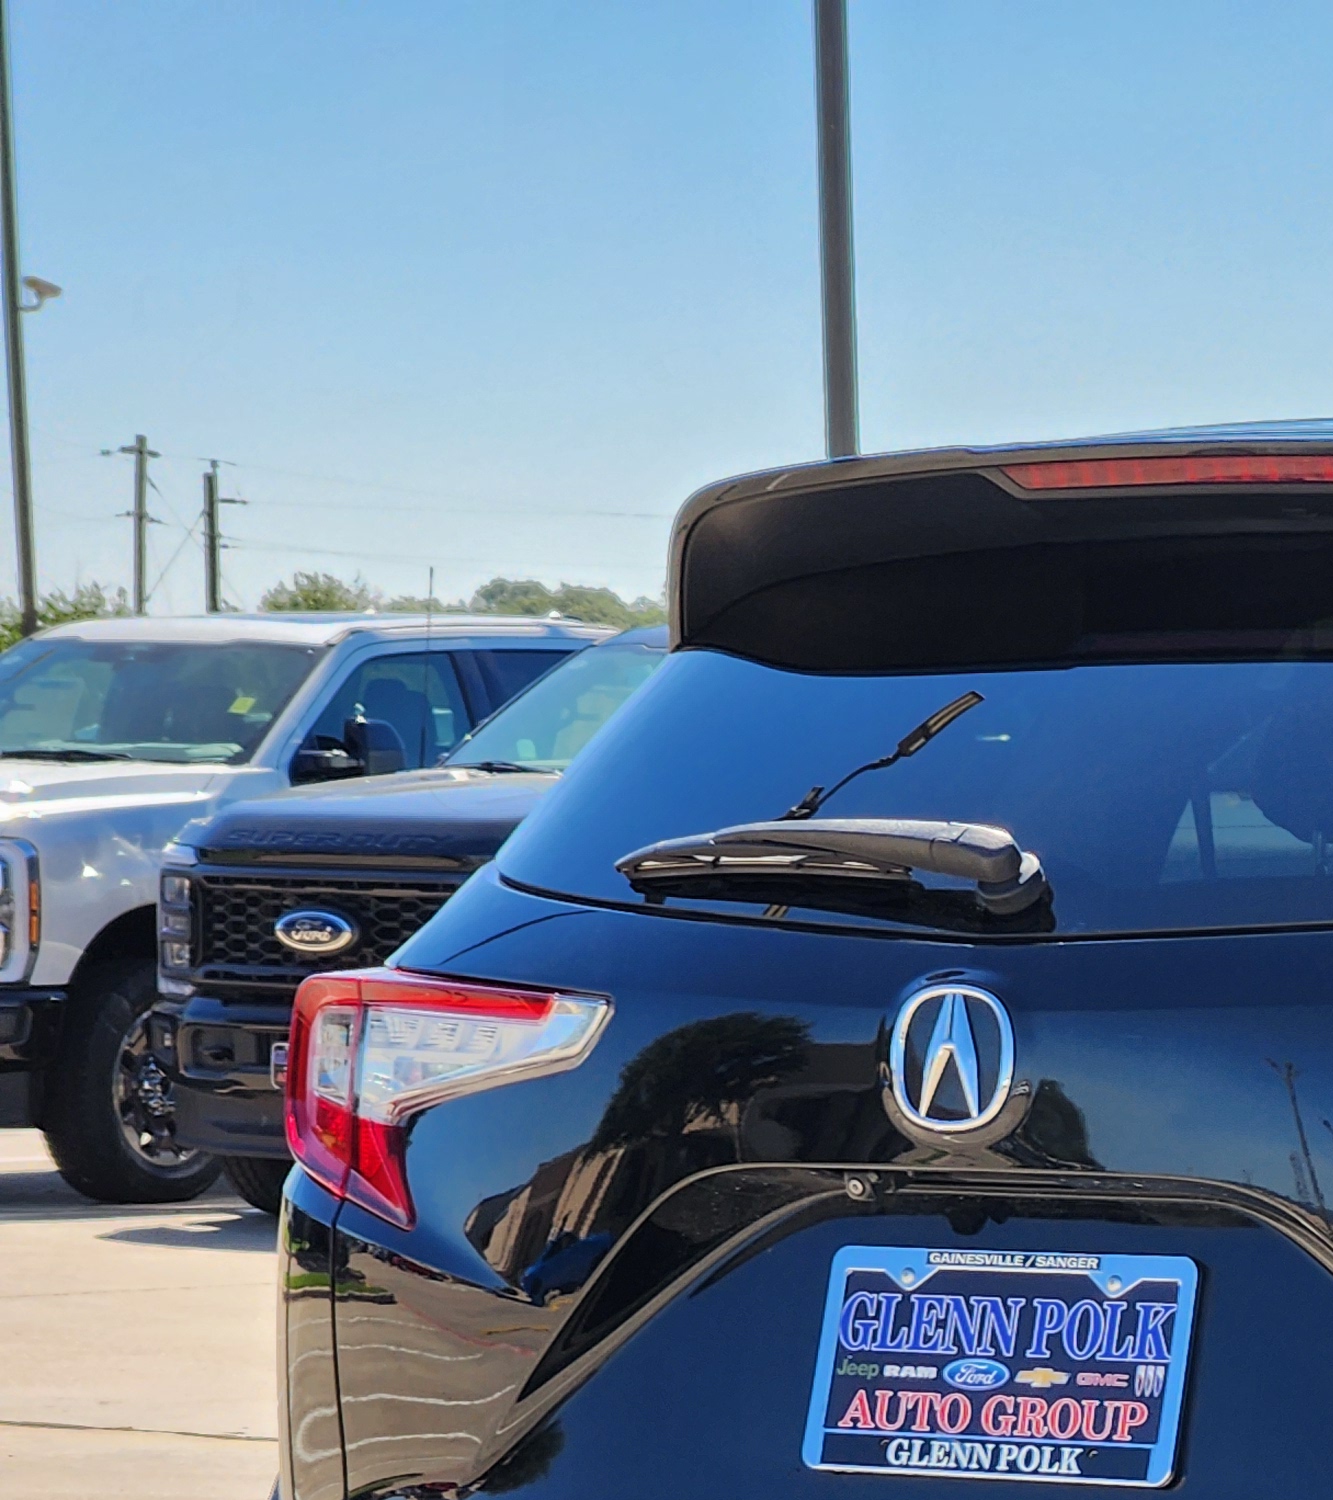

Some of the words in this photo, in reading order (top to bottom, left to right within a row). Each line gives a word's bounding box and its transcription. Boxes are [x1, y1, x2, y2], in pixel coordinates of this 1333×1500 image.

[227, 828, 342, 846] SUPER
[290, 919, 334, 941] Ford
[838, 1291, 1026, 1358] GLENN
[1025, 1297, 1178, 1363] POLK
[836, 1356, 879, 1380] Jeep
[883, 1364, 938, 1379] RAM
[953, 1363, 997, 1384] Ford
[1075, 1372, 1130, 1387] GMC
[837, 1388, 973, 1432] AUTO
[980, 1394, 1149, 1442] GROUP
[885, 1438, 1000, 1471] GLENN
[994, 1442, 1086, 1475] POLK
